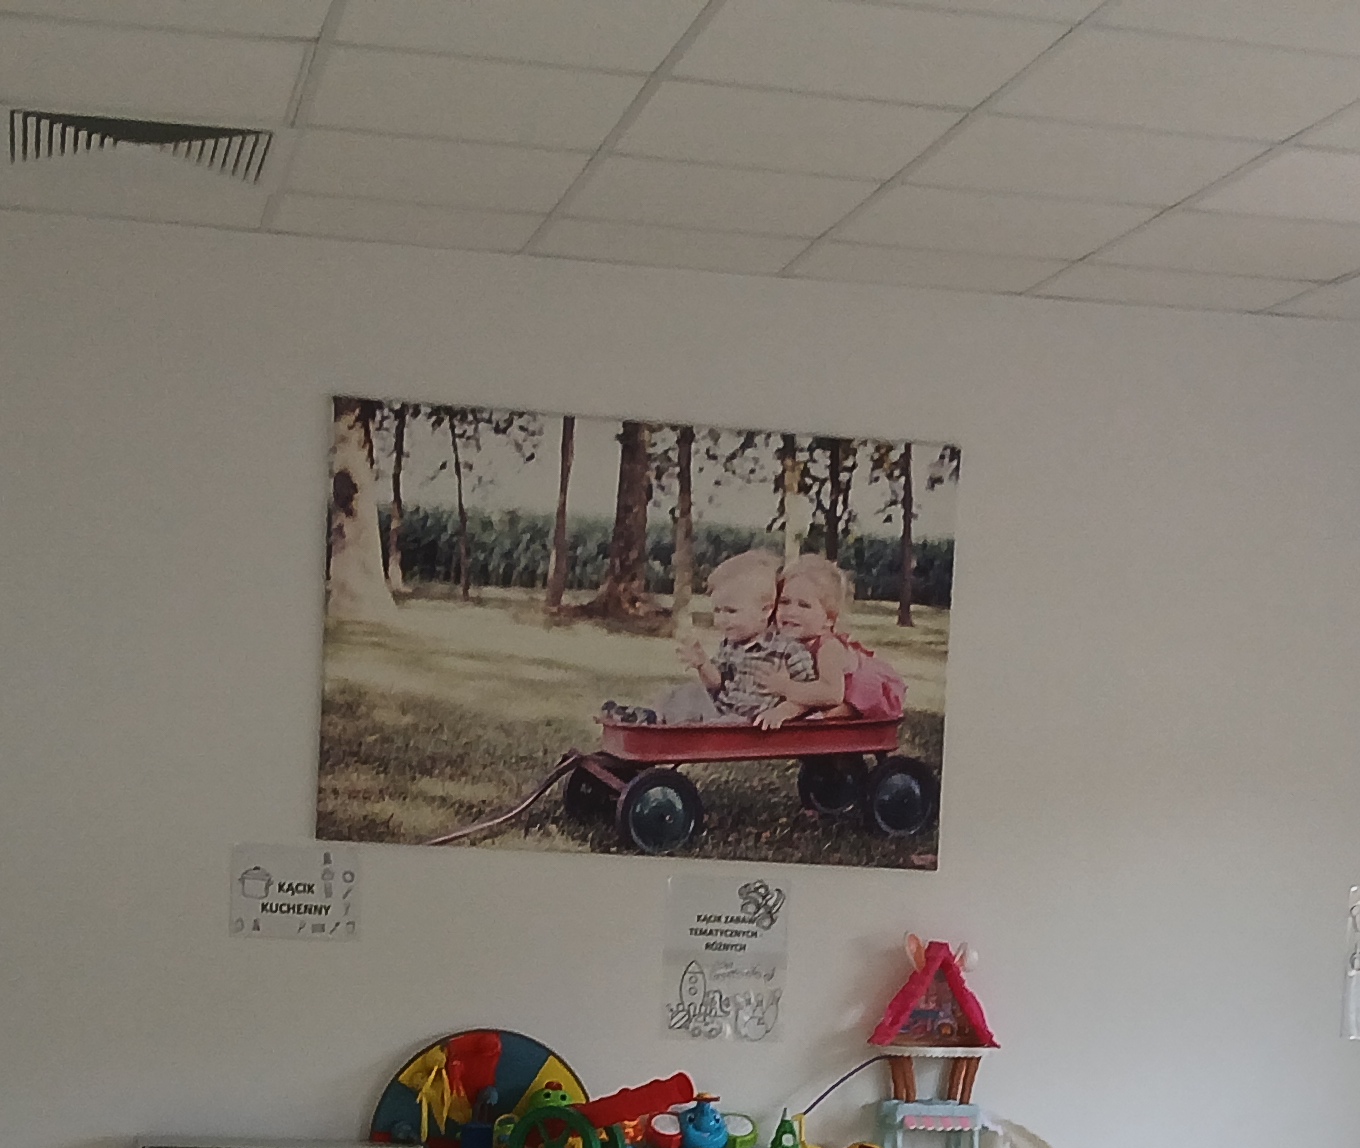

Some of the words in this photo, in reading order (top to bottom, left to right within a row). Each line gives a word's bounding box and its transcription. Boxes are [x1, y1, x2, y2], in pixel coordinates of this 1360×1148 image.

[277, 881, 315, 896] KĄCIK
[261, 902, 331, 916] KUCHENNY
[689, 928, 758, 938] TEMATYCZNYCH
